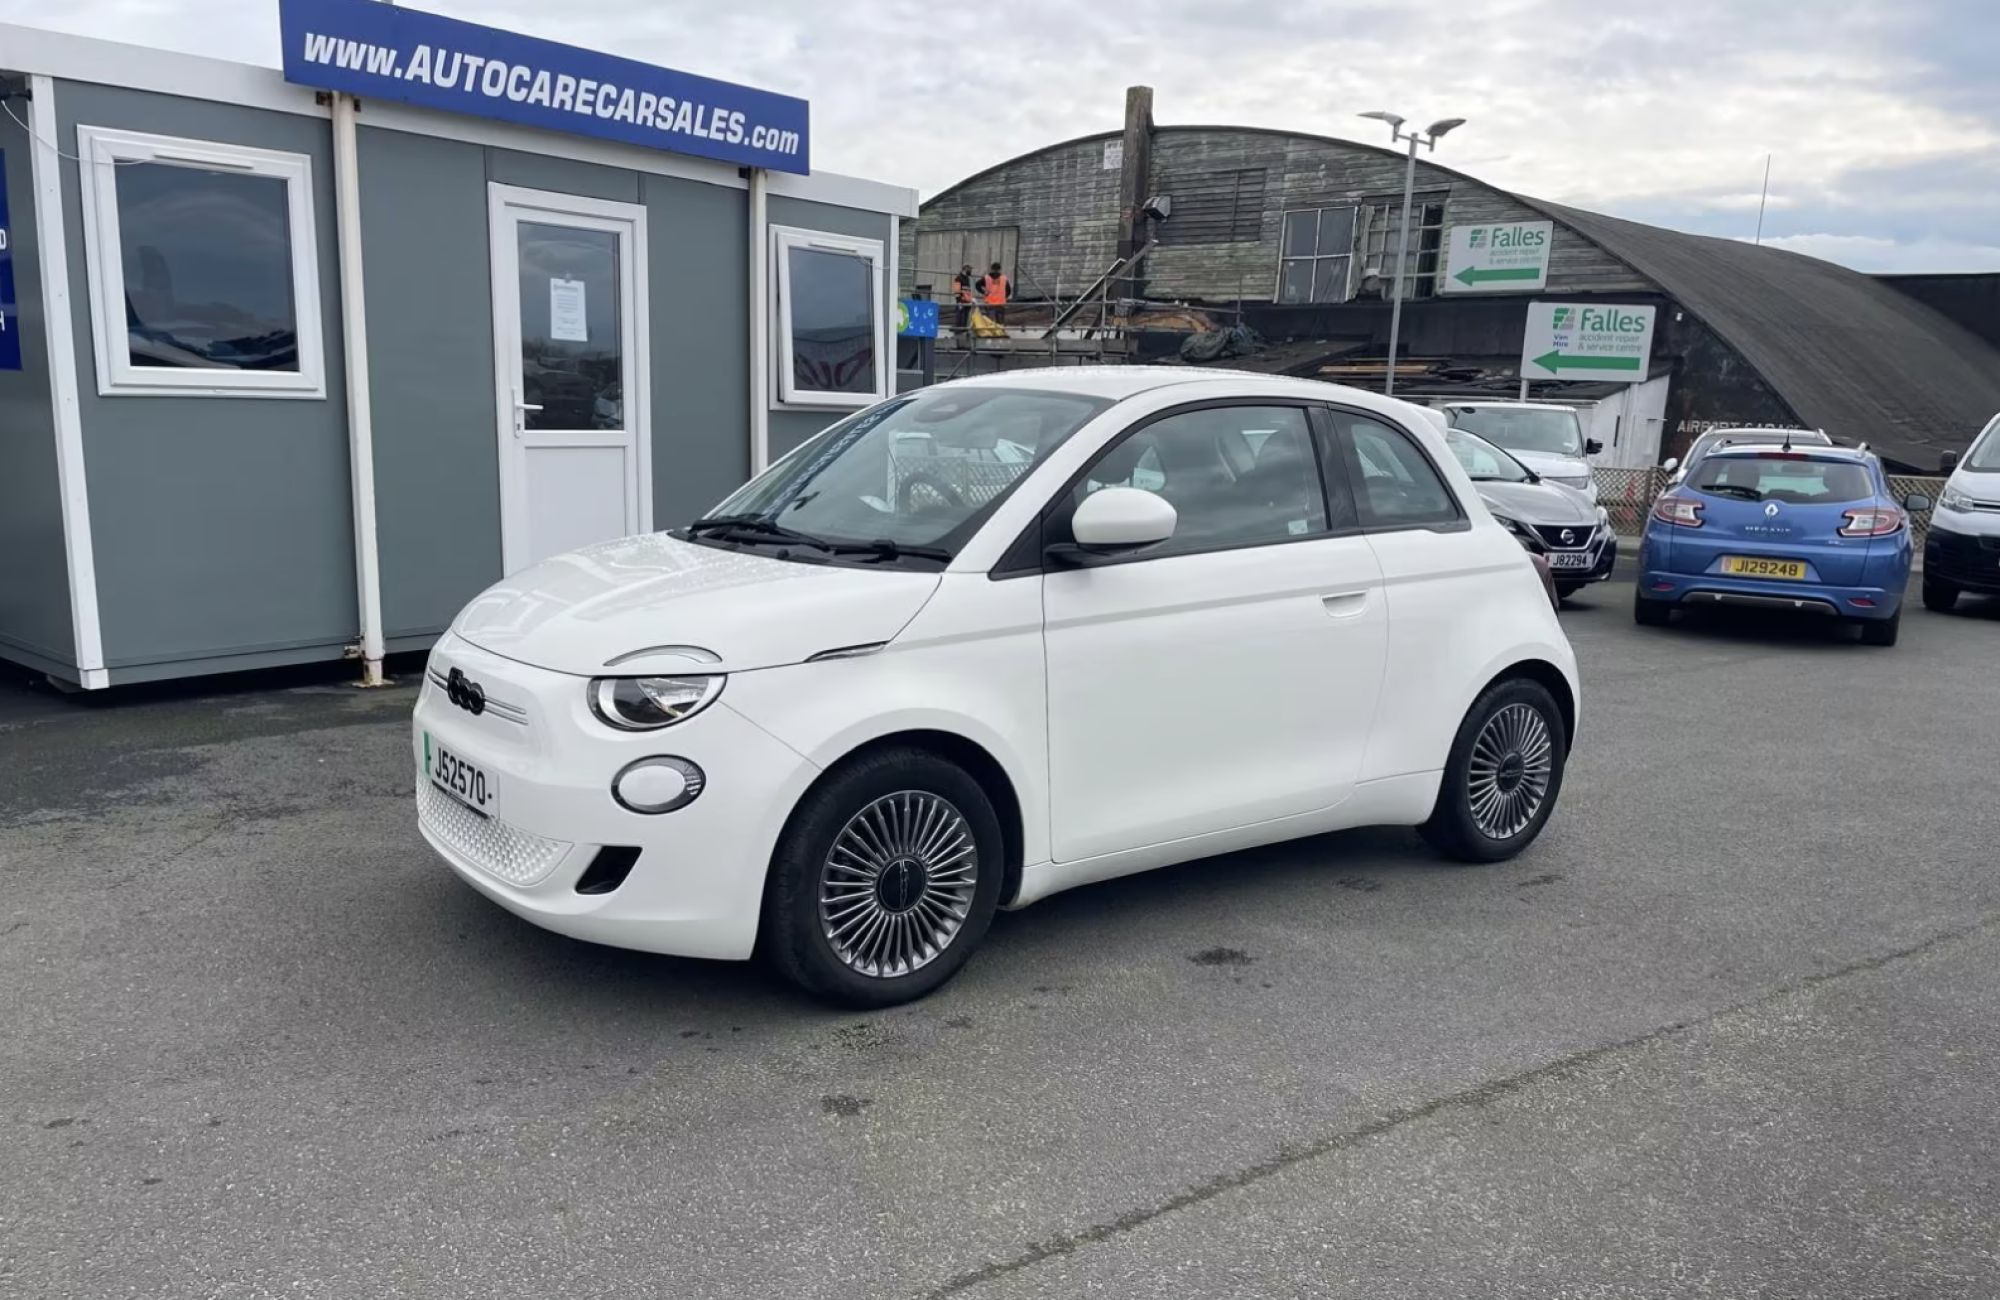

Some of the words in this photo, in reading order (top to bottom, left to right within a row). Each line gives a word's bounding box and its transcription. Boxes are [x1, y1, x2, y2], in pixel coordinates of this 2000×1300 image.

[304, 32, 799, 155] www.AUTOCARECARSALES.com
[1491, 226, 1545, 248] Falles
[1581, 308, 1646, 333] Falles
[435, 746, 486, 806] J52570
